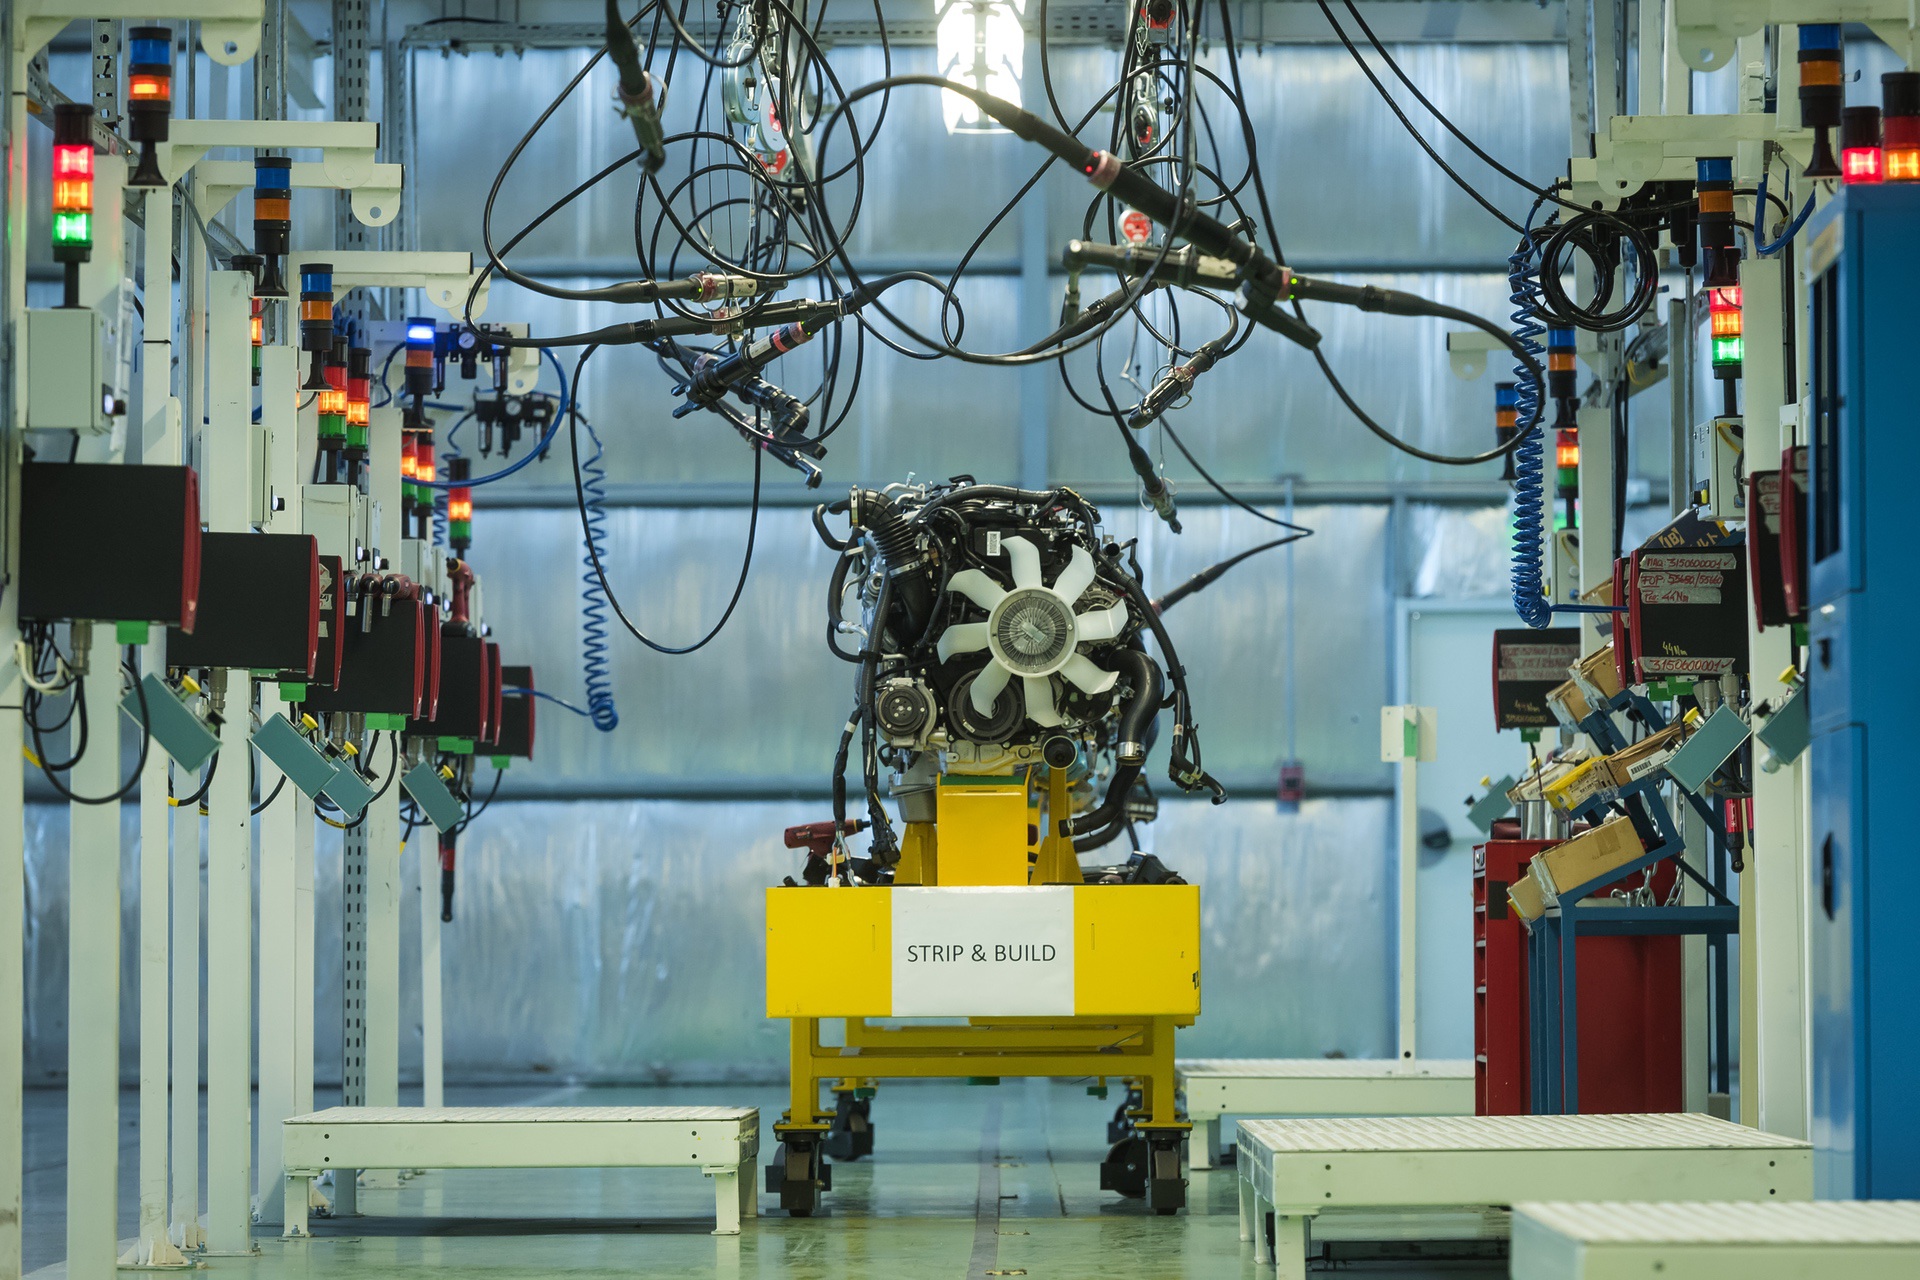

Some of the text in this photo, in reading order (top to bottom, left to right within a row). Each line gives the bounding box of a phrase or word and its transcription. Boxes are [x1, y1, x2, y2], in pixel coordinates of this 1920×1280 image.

[1650, 659, 1721, 672] 3150600001
[907, 944, 1056, 962] STRIP & BUILD
